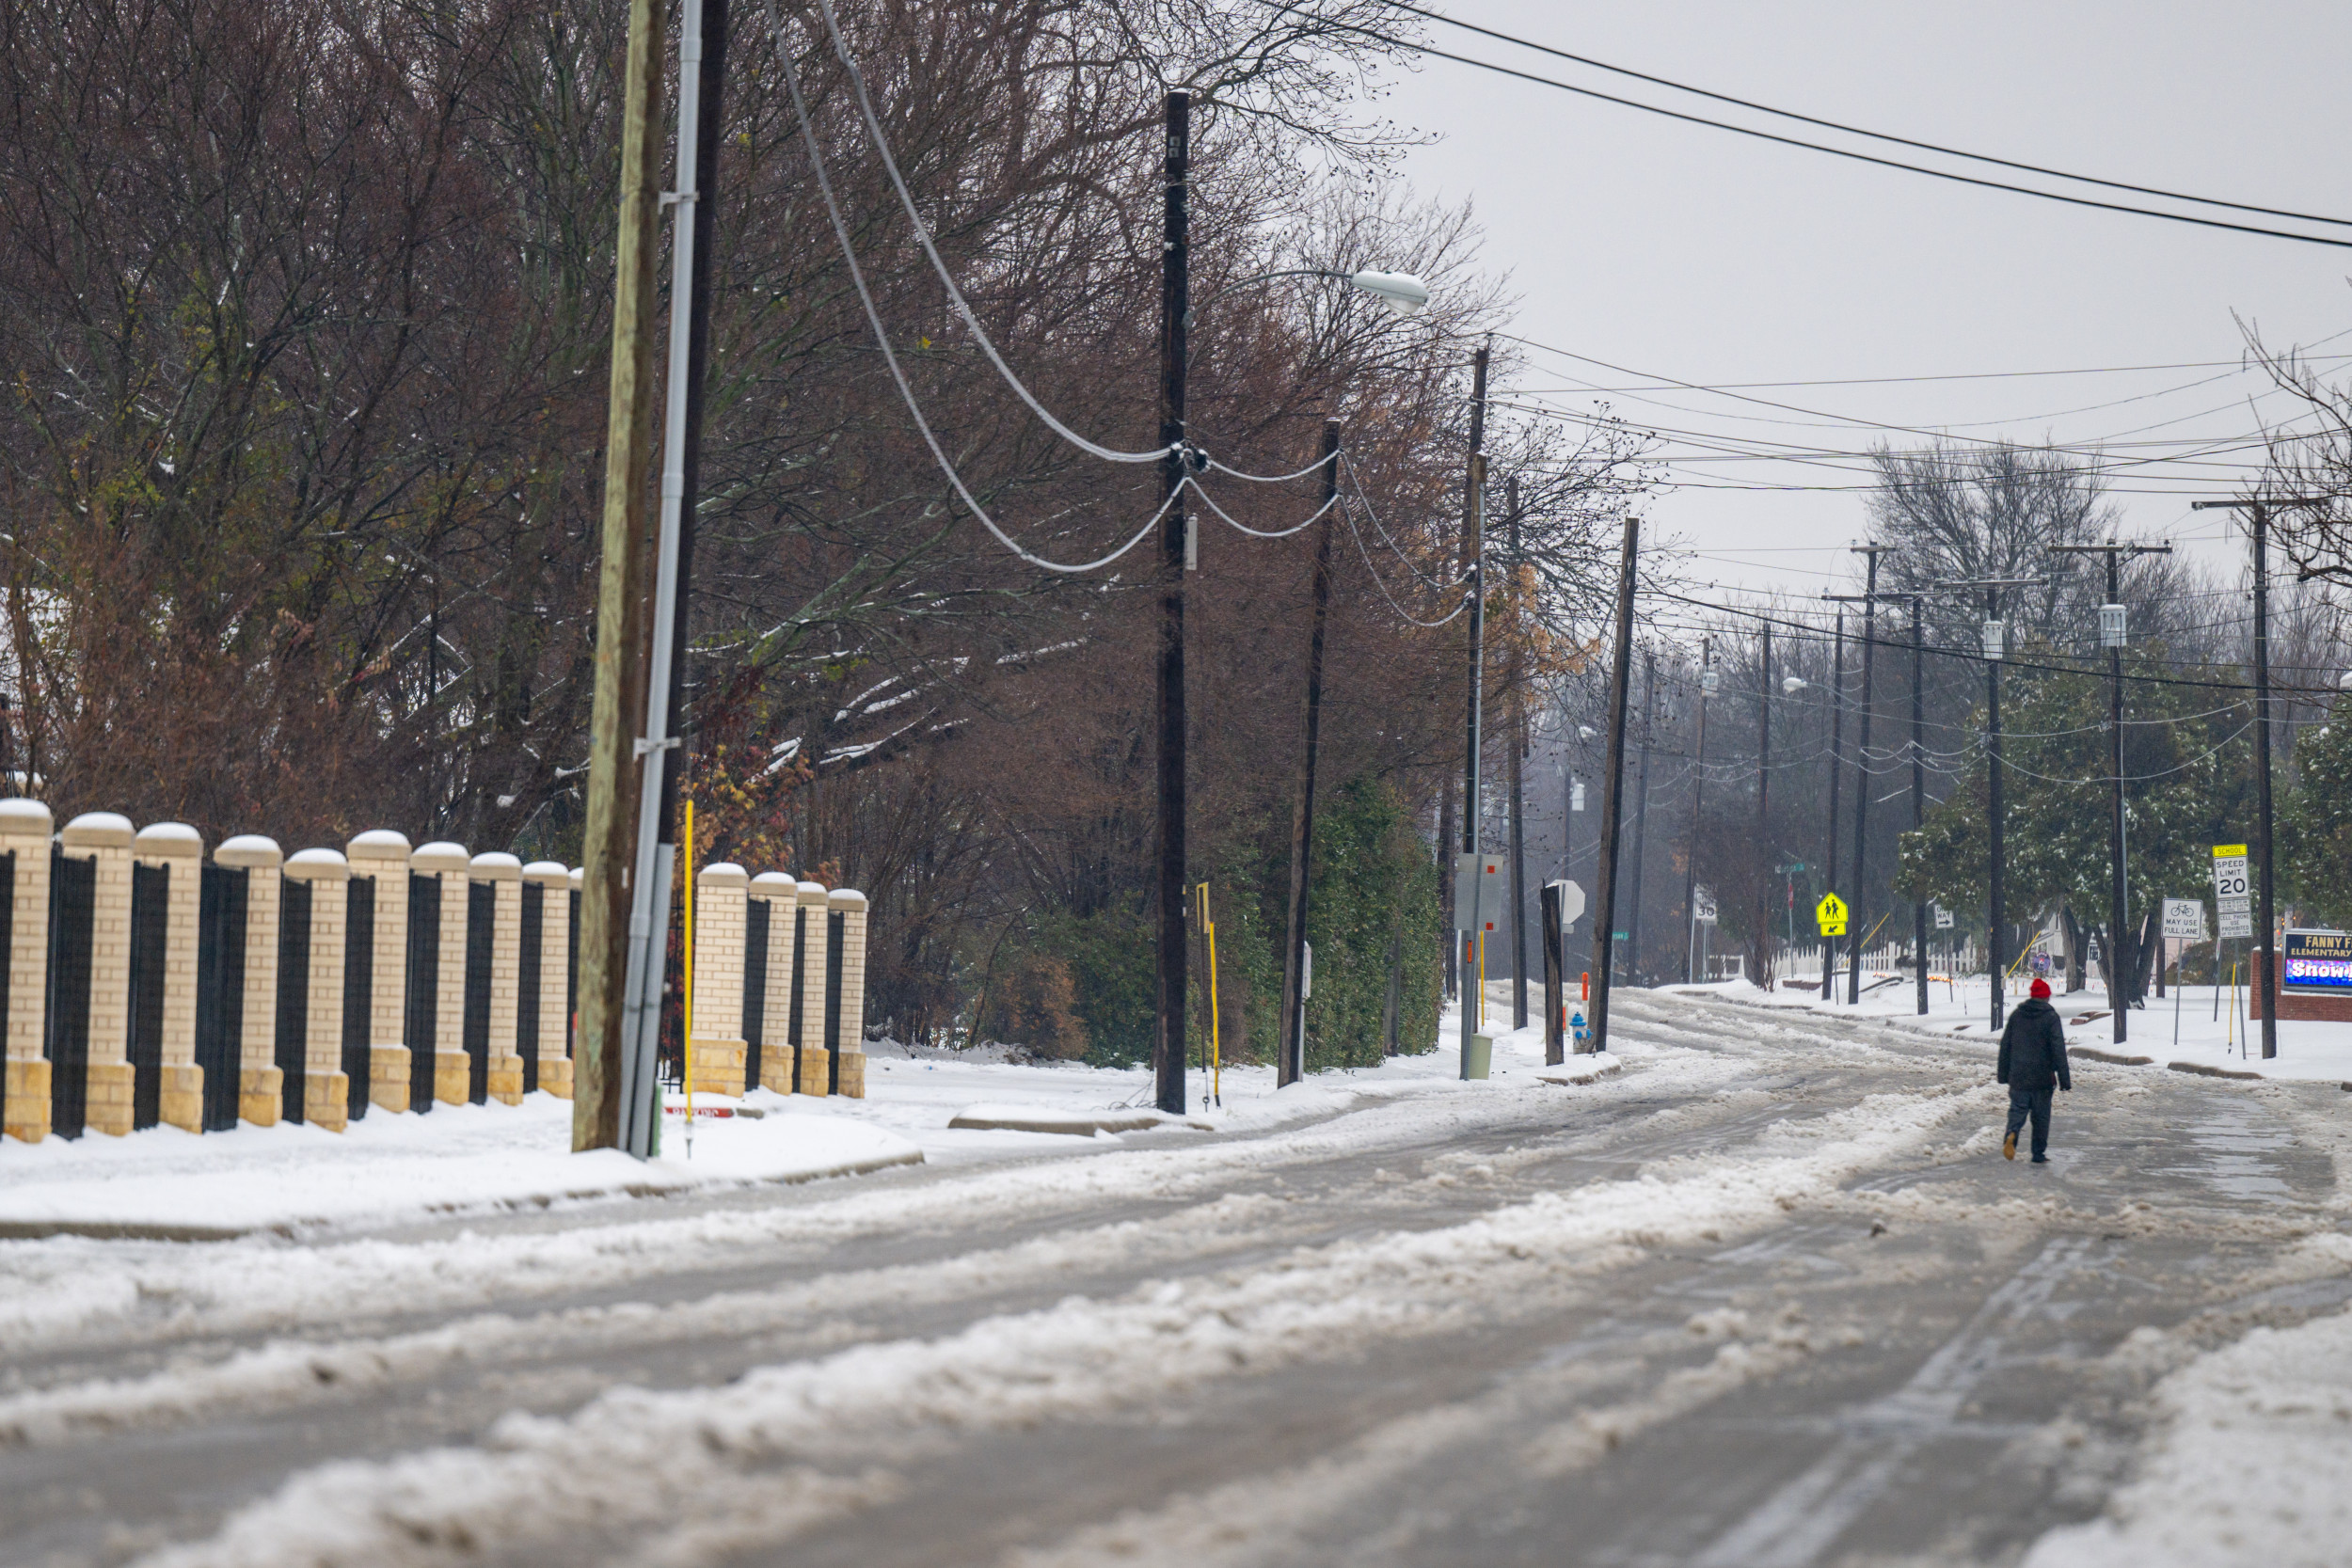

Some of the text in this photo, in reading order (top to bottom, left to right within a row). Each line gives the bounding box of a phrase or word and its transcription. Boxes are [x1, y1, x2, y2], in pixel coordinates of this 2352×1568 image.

[2217, 847, 2243, 855] SCHOOL
[2217, 860, 2245, 868] SPEED
[2219, 878, 2246, 895] 20
[1697, 907, 1715, 917] 30
[2306, 936, 2352, 948] FANNY F
[2291, 948, 2352, 957] ELEMENTARY
